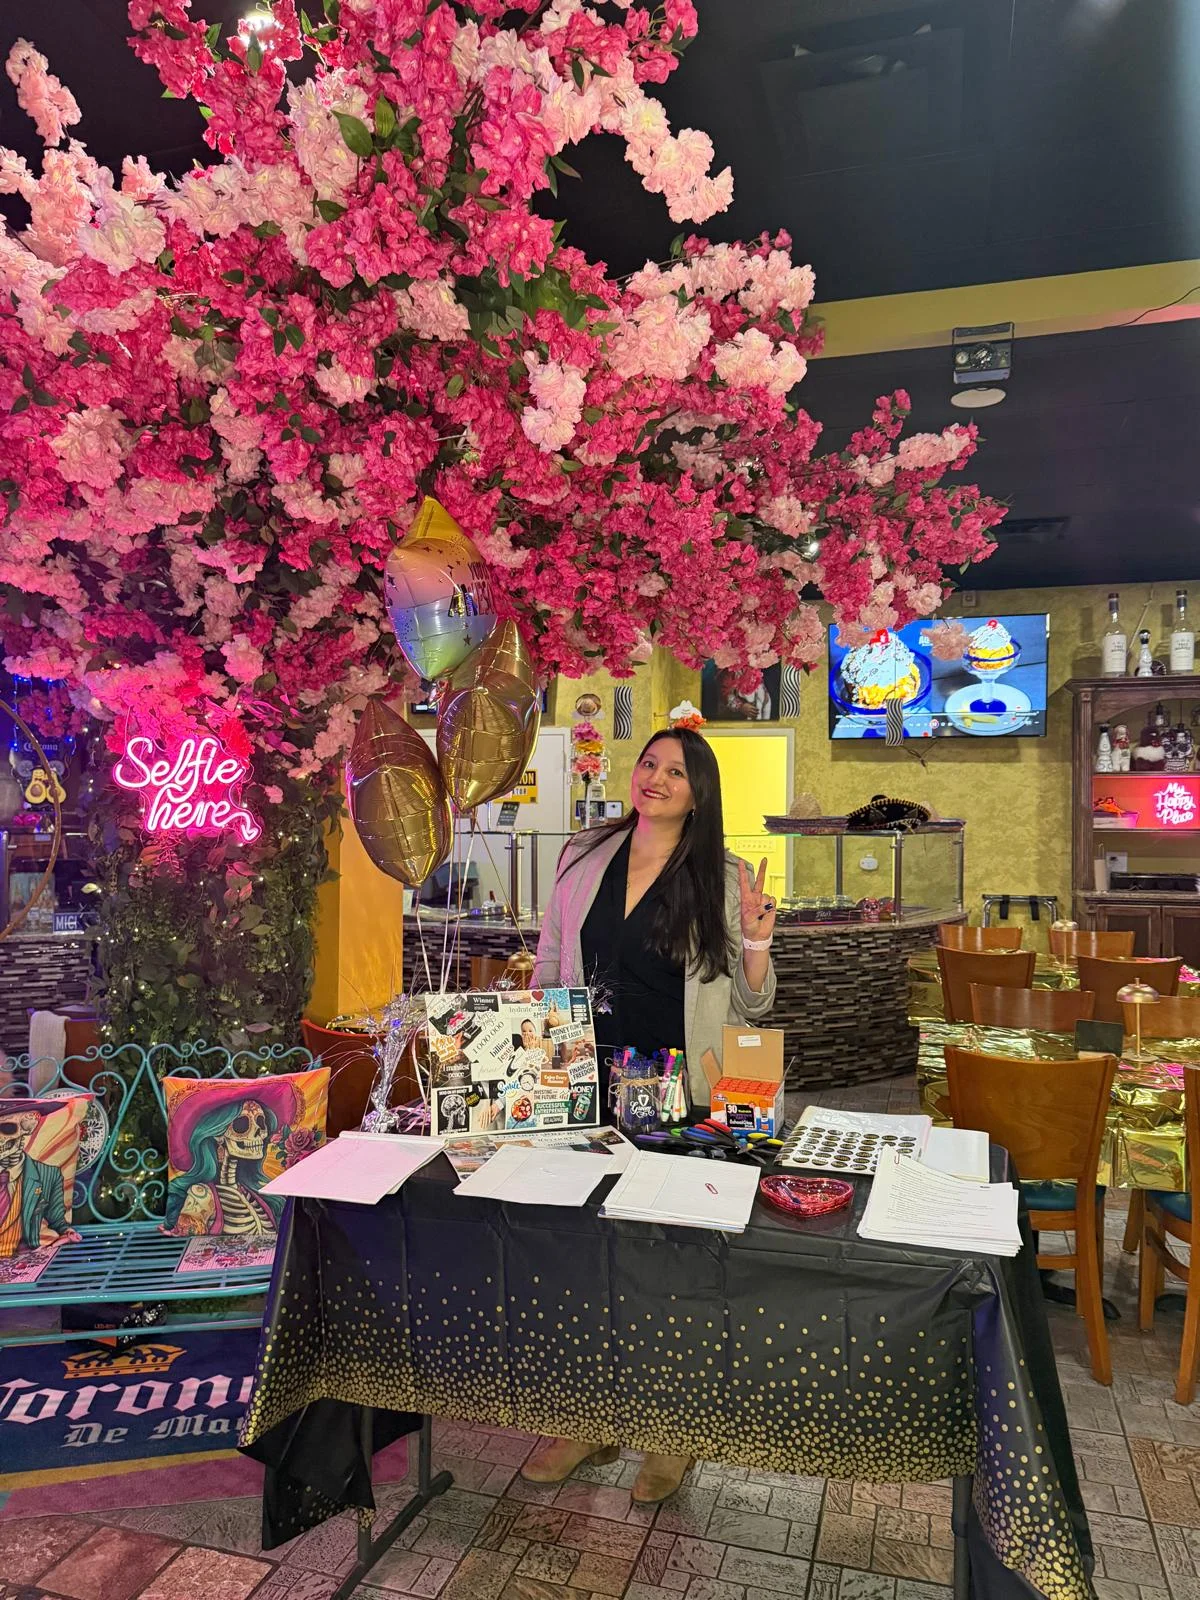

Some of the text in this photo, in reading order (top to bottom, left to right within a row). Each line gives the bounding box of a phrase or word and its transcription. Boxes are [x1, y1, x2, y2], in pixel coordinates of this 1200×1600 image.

[114, 736, 245, 800] Selfie
[1159, 782, 1192, 798] My
[147, 784, 236, 832] here
[1153, 792, 1197, 811] Happy
[1155, 808, 1194, 825] Place
[473, 996, 495, 1004] Winner
[551, 1027, 570, 1036] MONEY
[490, 1037, 510, 1058] billion
[570, 1060, 595, 1075] FINANCIAL
[573, 1066, 596, 1081] FREEDOM
[497, 1079, 521, 1098] Smile
[571, 1085, 595, 1093] MONEY
[727, 1105, 737, 1113] 30
[61, 1422, 129, 1448] De
